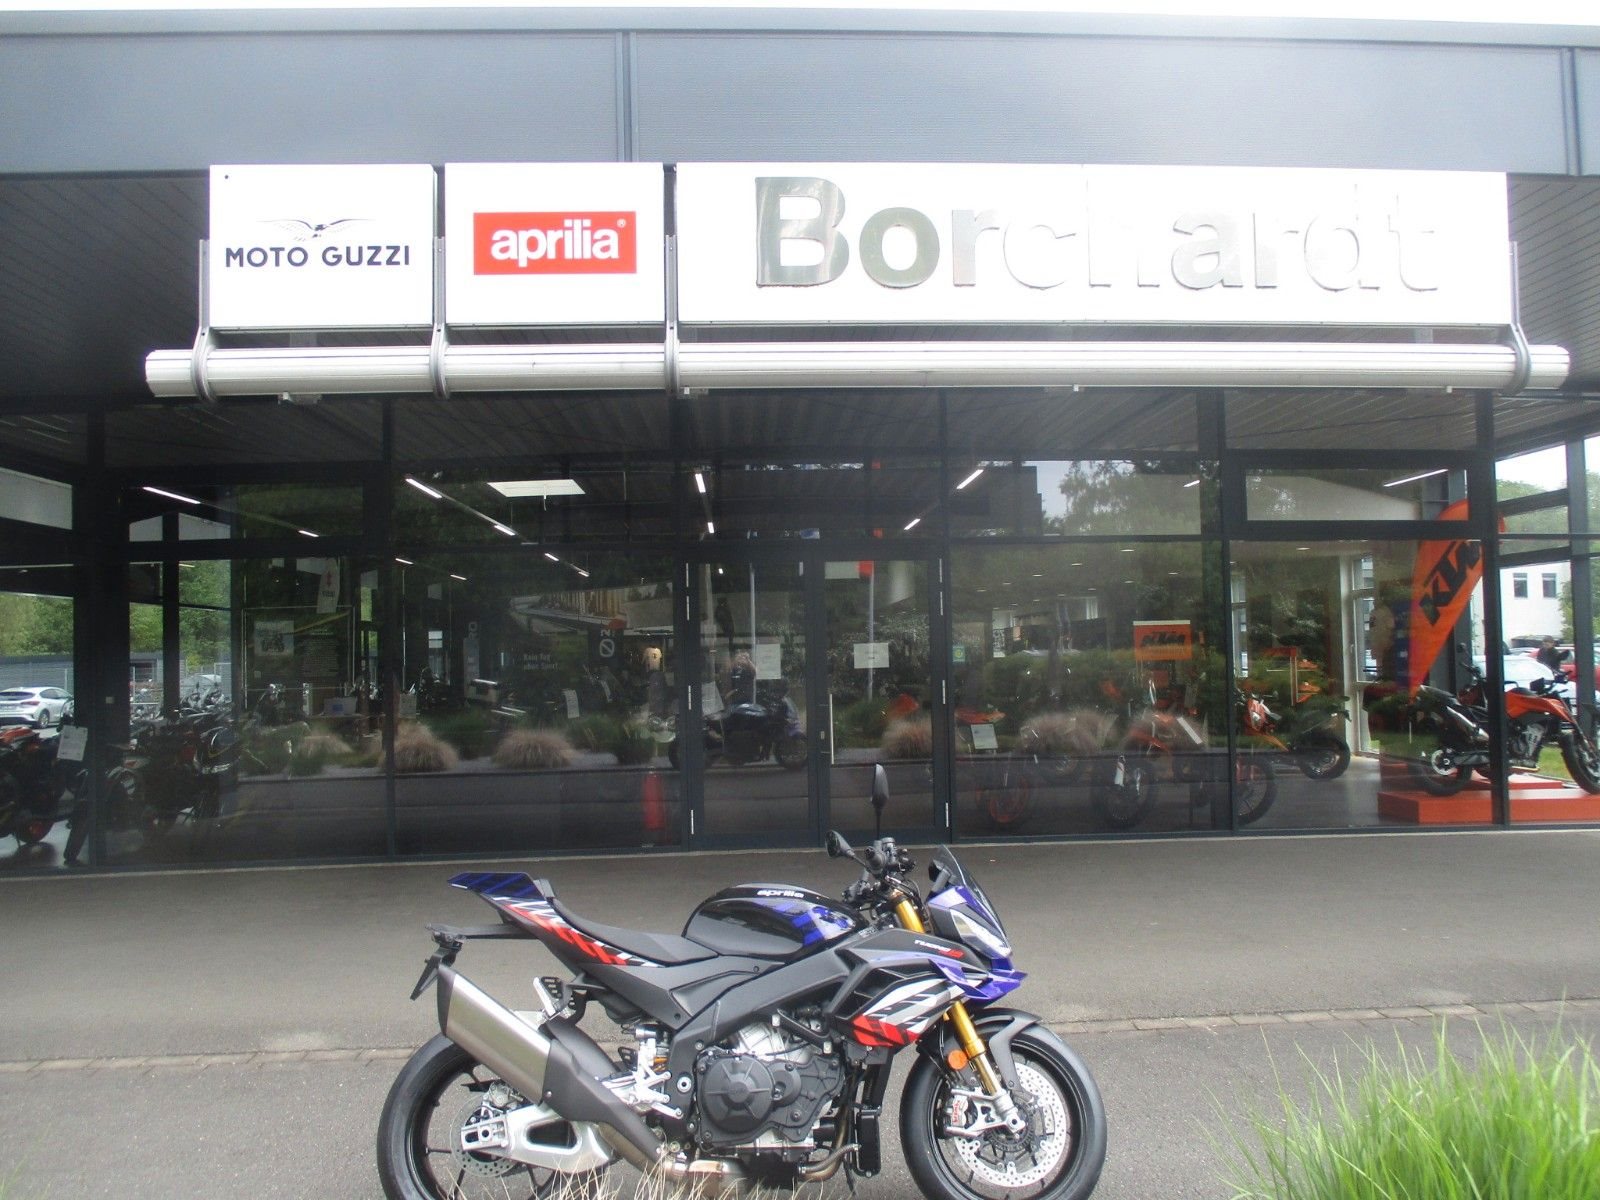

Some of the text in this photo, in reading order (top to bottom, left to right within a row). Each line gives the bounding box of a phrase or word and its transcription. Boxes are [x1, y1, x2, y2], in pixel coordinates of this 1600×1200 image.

[226, 245, 410, 267] MOTO GUZZI
[491, 219, 619, 267] aprilia
[755, 176, 1438, 291] Borchardt
